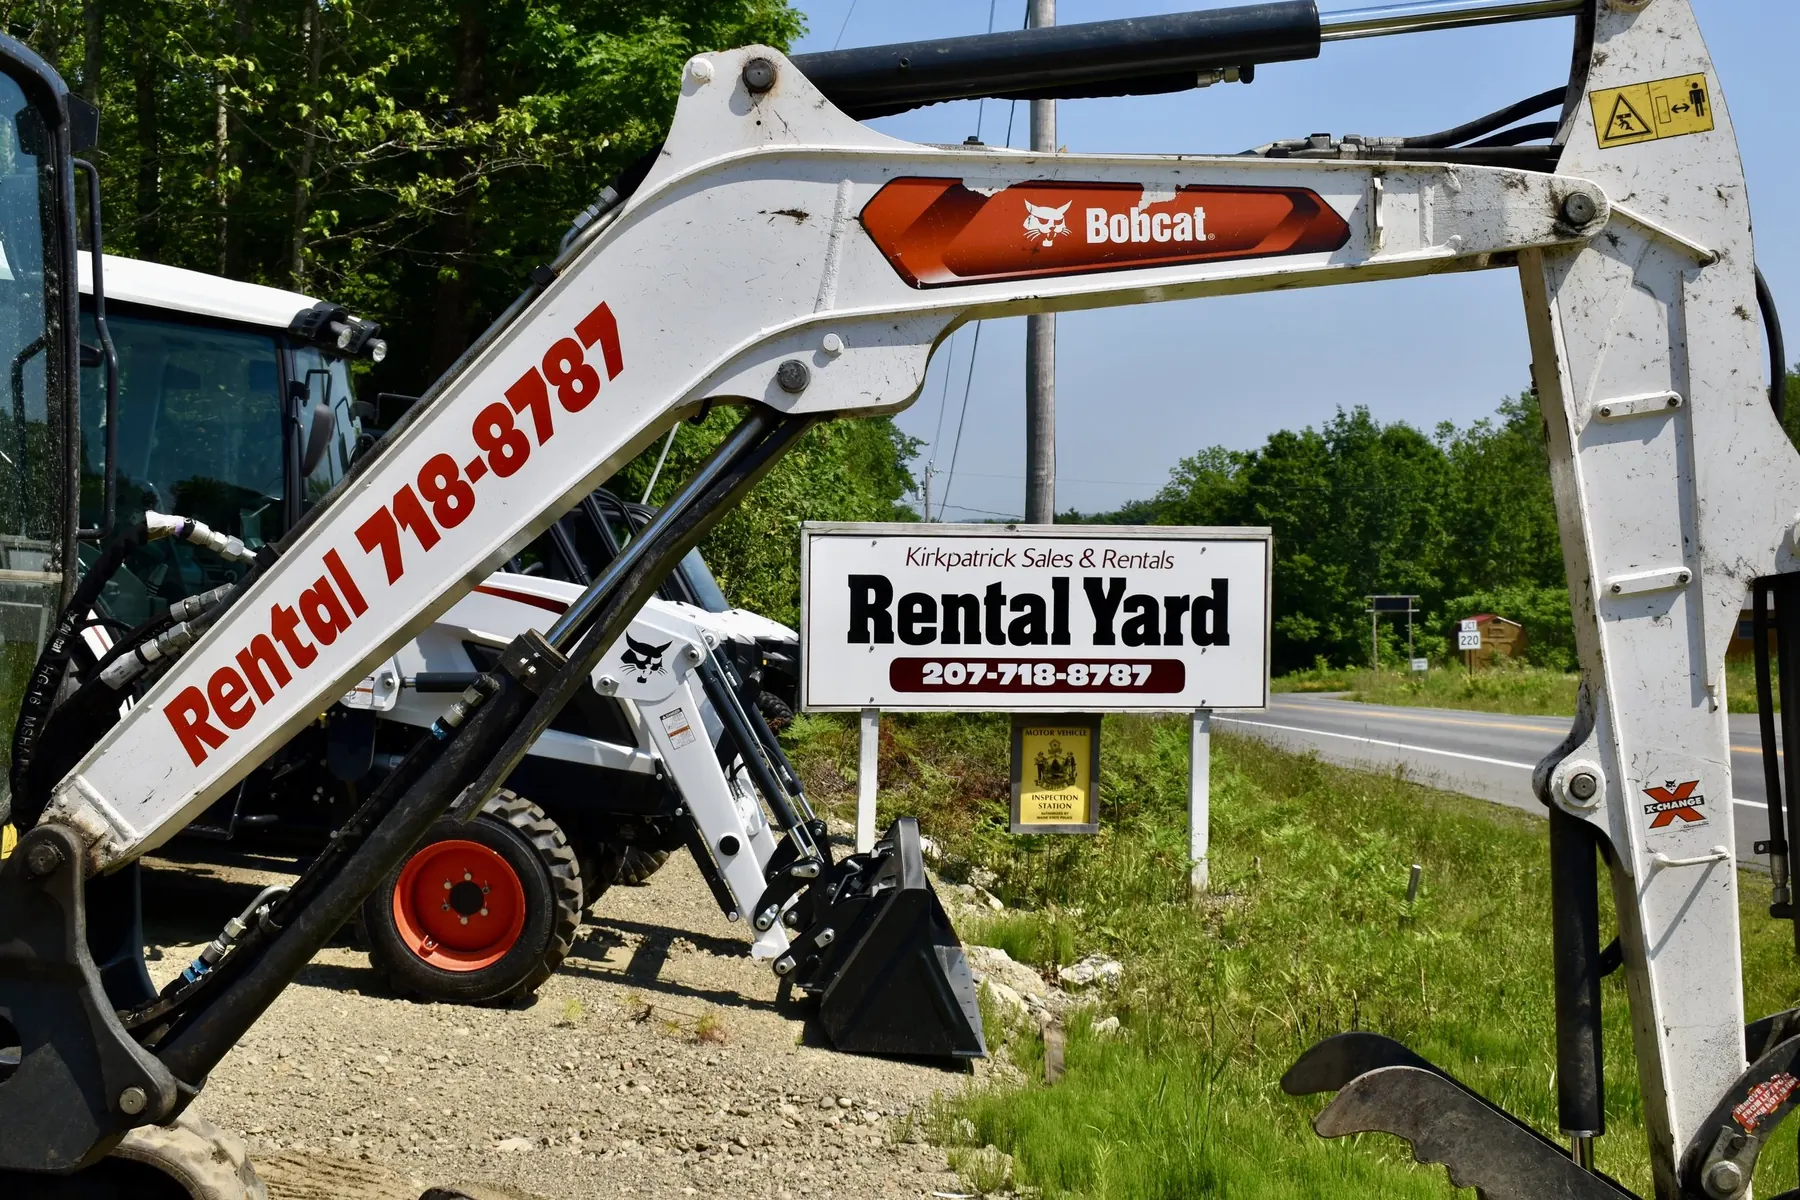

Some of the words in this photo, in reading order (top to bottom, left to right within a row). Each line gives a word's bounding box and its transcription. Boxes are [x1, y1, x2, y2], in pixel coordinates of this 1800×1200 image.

[1086, 206, 1207, 244] Bobcat
[162, 547, 369, 768] Rental
[353, 300, 625, 587] 718-8787
[905, 546, 1017, 572] Kirkpatrick
[1022, 547, 1074, 569] Sales
[1078, 549, 1097, 569] &
[1102, 549, 1175, 570] Rentals
[847, 574, 1071, 647] Rental
[1083, 576, 1231, 648] Yard
[1463, 621, 1476, 630] JCT
[1460, 635, 1479, 646] 220
[28, 663, 55, 706] HG-16
[922, 661, 1153, 687] 207-718-8787
[1025, 729, 1055, 737] MOTOR
[1057, 729, 1088, 737] VEHICLE
[1038, 802, 1072, 810] STATION
[1645, 796, 1702, 814] X-CHANGE
[1733, 1087, 1763, 1114] REMOVE
[1741, 1099, 1762, 1118] FROM
[1759, 1086, 1776, 1102] LIFT
[1764, 1093, 1780, 1109] NOT
